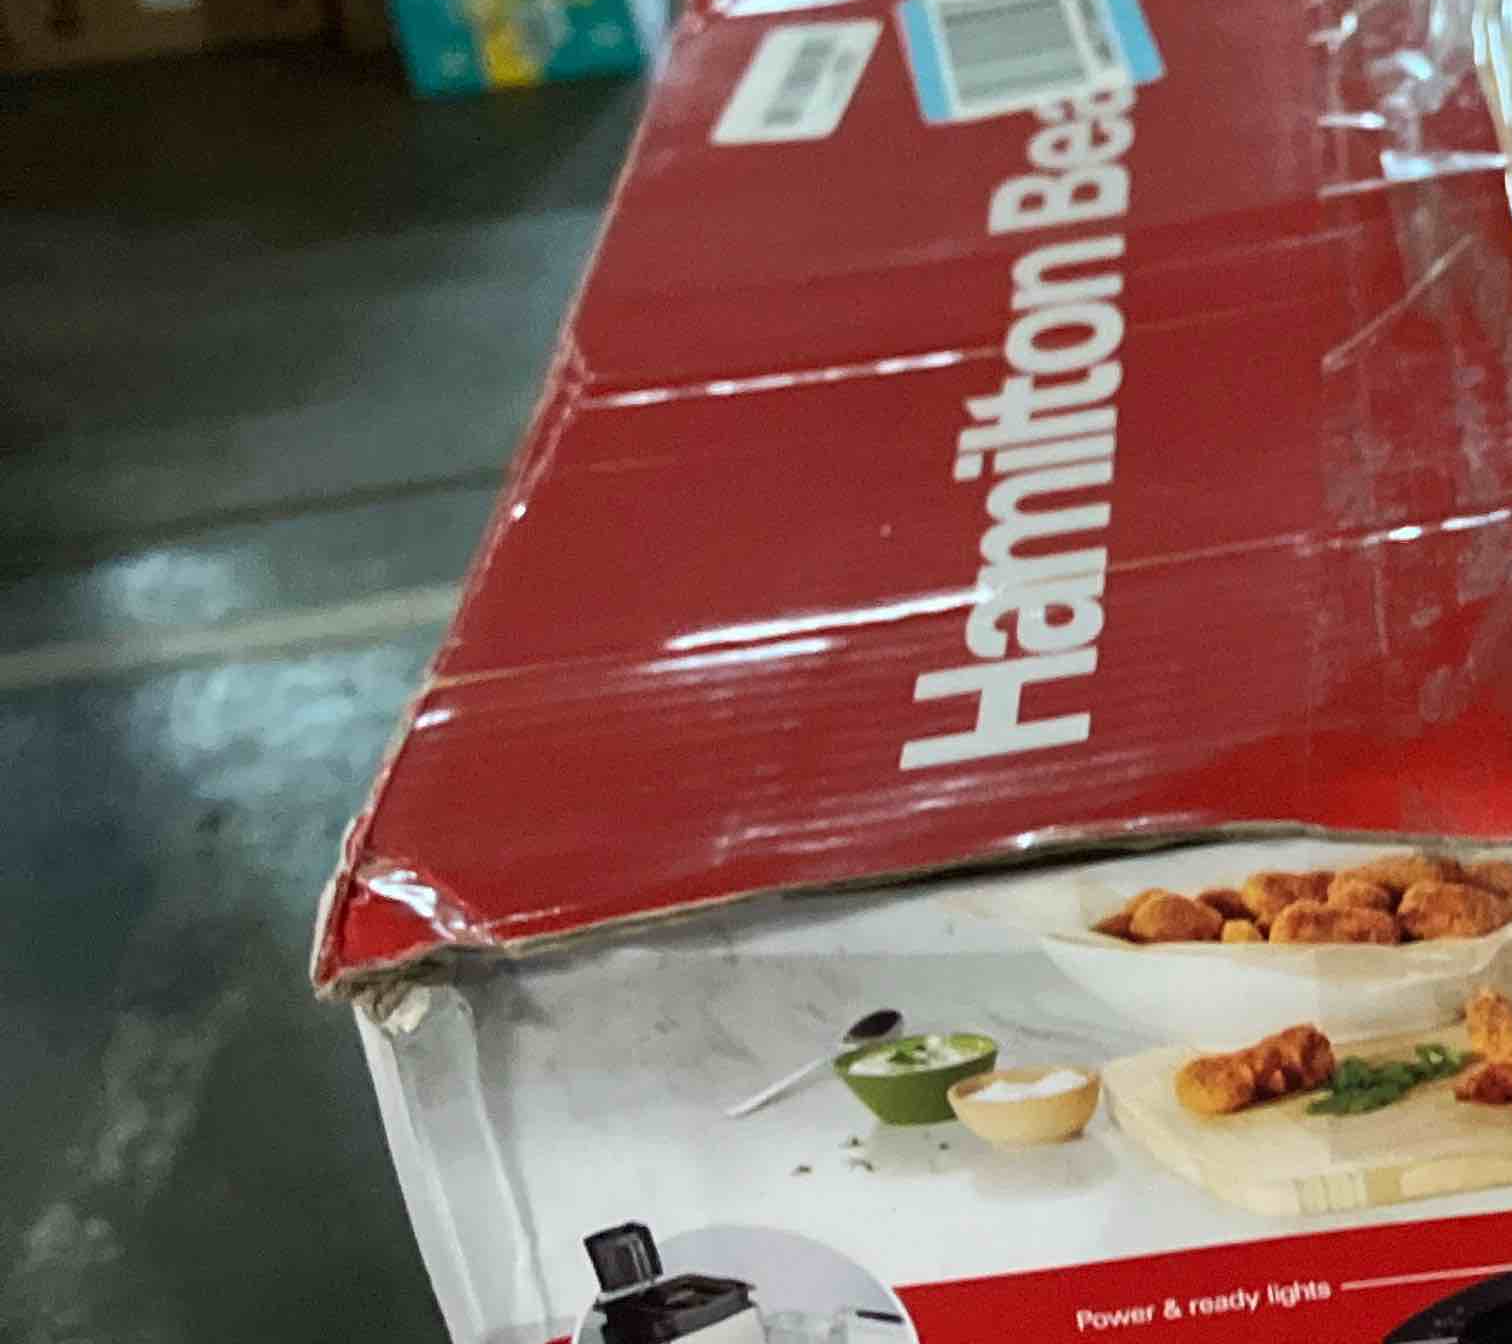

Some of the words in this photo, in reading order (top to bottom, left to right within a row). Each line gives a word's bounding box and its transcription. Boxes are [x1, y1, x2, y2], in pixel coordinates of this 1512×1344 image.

[987, 74, 1137, 237] Bea
[900, 234, 1126, 771] Hamilton
[1075, 1304, 1156, 1332] Power
[1162, 1298, 1182, 1320] &
[1189, 1287, 1260, 1316] ready
[1266, 1280, 1332, 1308] lights
